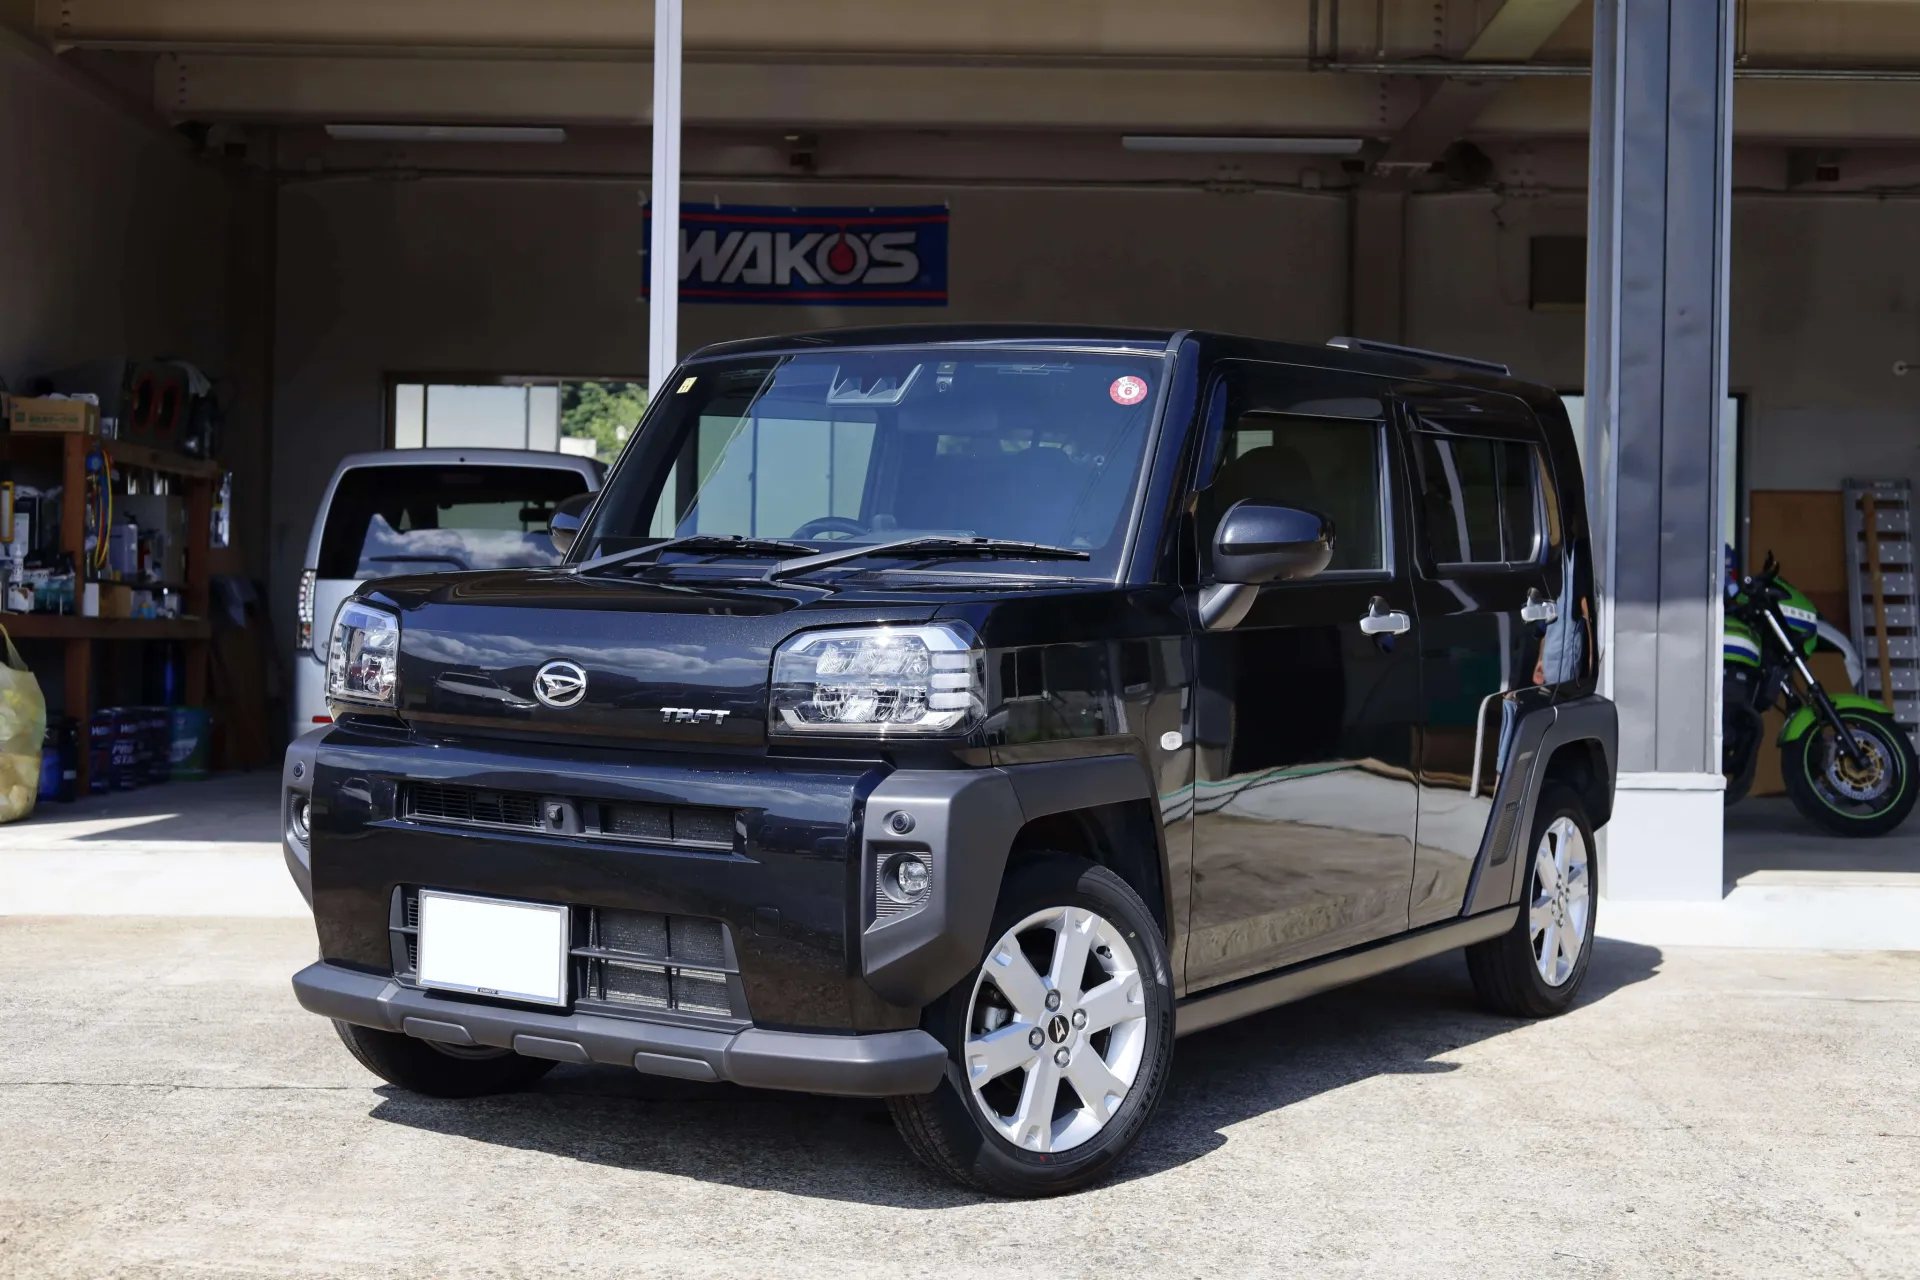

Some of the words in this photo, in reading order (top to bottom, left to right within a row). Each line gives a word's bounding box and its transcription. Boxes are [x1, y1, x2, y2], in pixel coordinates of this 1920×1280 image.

[679, 229, 919, 285] WAKO'S
[1124, 386, 1133, 396] 6
[660, 707, 731, 725] TAFT
